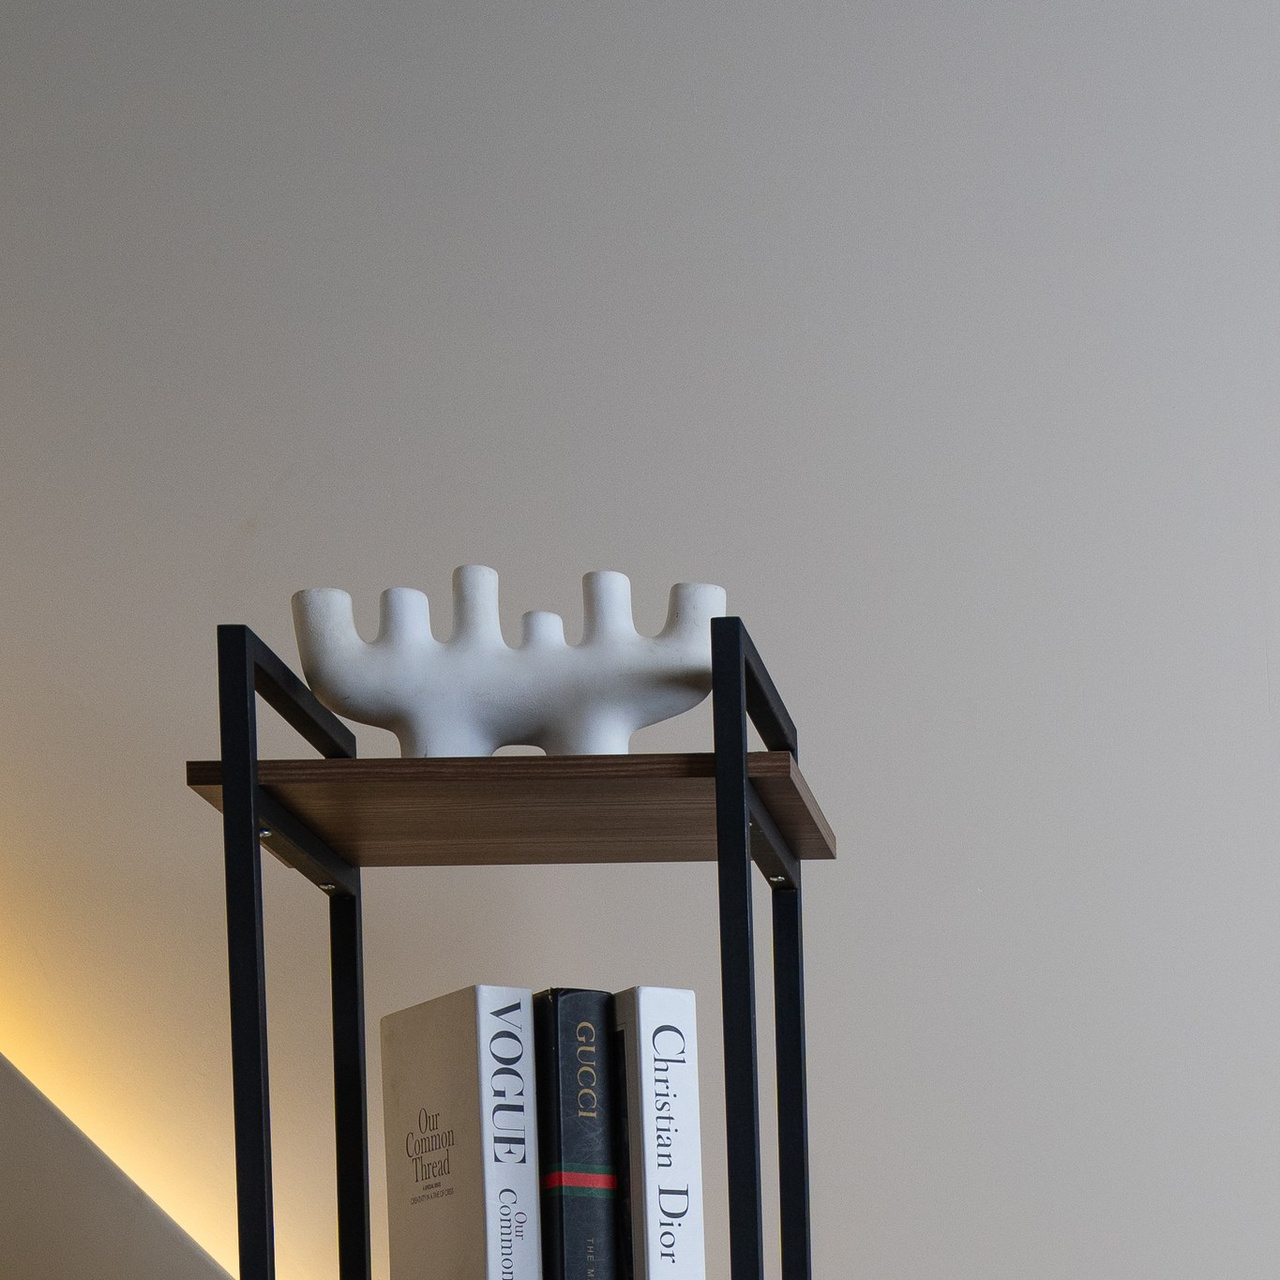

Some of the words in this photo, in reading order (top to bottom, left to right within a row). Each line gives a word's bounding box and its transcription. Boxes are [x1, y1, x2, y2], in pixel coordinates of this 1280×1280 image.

[489, 998, 527, 1164] VOGUE
[576, 1021, 598, 1119] GUCCI
[652, 1024, 687, 1169] Christian
[418, 1107, 440, 1134] Our
[405, 1129, 455, 1158] Common
[412, 1148, 451, 1183] Thread
[514, 1211, 528, 1241] Our
[658, 1183, 690, 1264] Dior
[586, 1237, 596, 1262] THE
